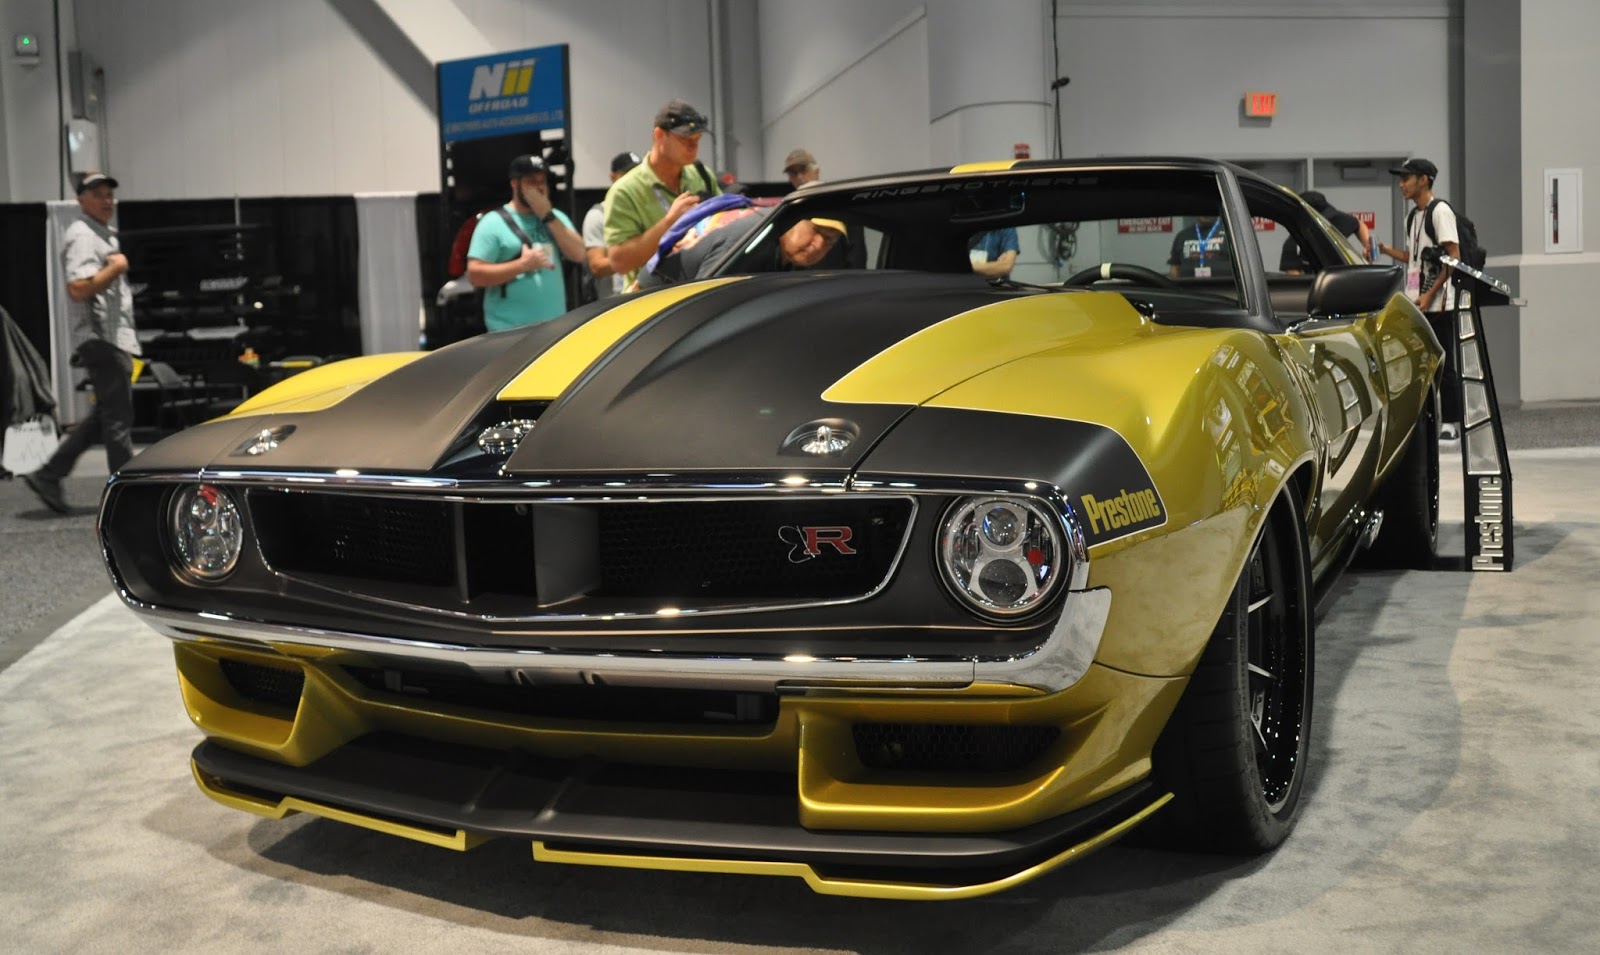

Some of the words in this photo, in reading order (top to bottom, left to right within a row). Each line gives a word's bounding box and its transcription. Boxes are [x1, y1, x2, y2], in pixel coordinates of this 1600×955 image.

[469, 97, 528, 115] OFFROAD
[1252, 93, 1275, 114] EXIT
[851, 176, 1099, 200] RINGBROTHERS
[1081, 488, 1161, 535] Prestone
[1472, 476, 1504, 571] Prestone
